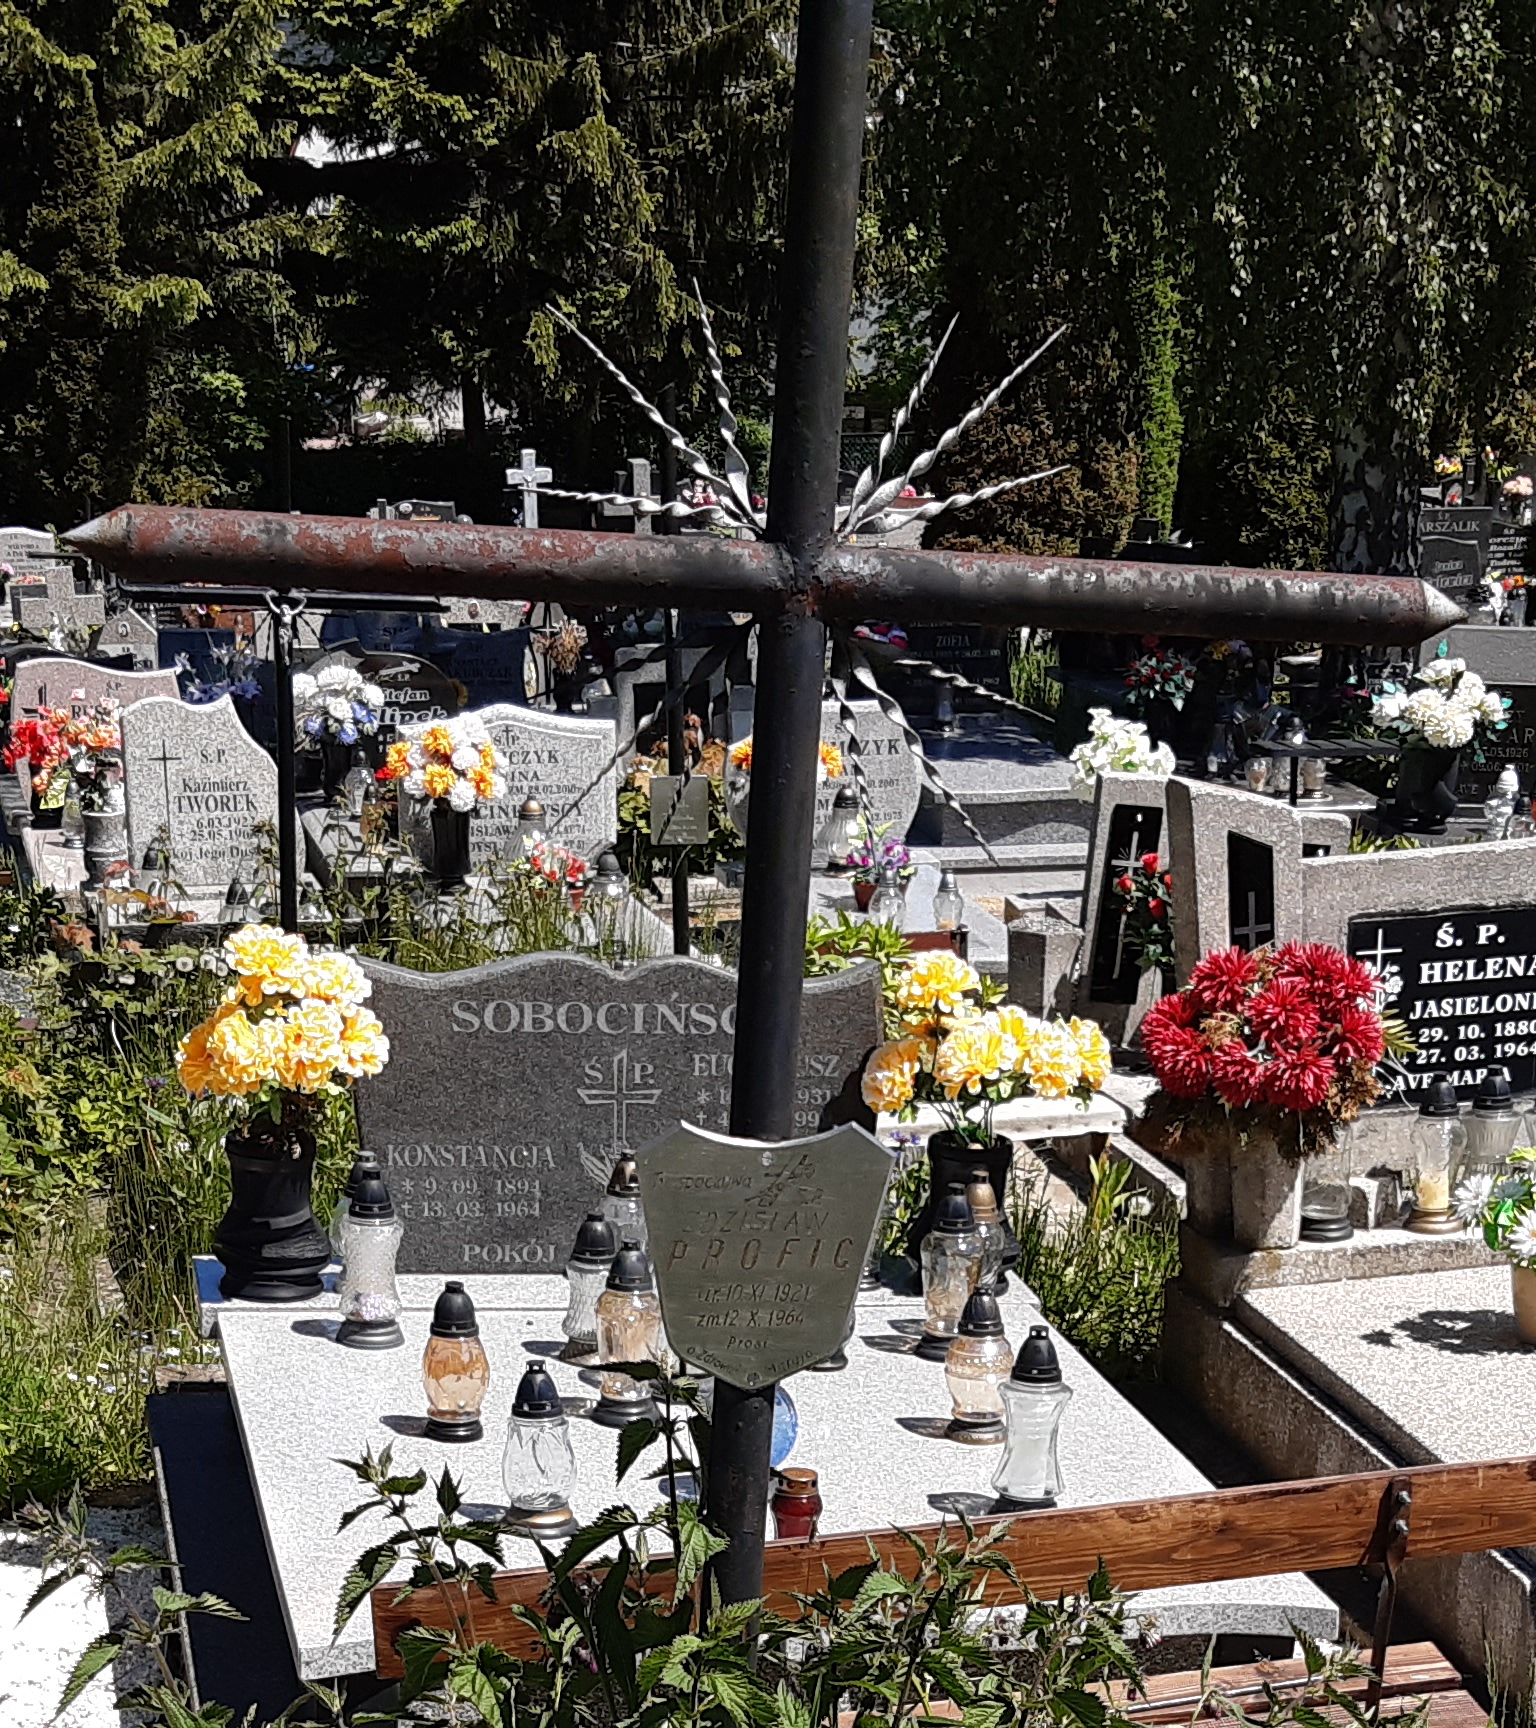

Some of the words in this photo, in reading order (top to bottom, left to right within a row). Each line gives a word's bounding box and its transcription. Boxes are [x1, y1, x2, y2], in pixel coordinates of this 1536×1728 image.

[1419, 520, 1481, 533] ARSZALIK
[172, 794, 258, 814] TWOREK
[1476, 924, 1506, 946] P.
[450, 991, 736, 1037] SOBOCIŃSC
[1418, 1026, 1450, 1044] 29.
[1458, 1023, 1486, 1041] 10.
[1415, 1047, 1446, 1066] 27.
[1453, 1044, 1486, 1063] 03.
[386, 1143, 557, 1170] KONSTANCJA
[463, 1238, 557, 1264] POKÓJ
